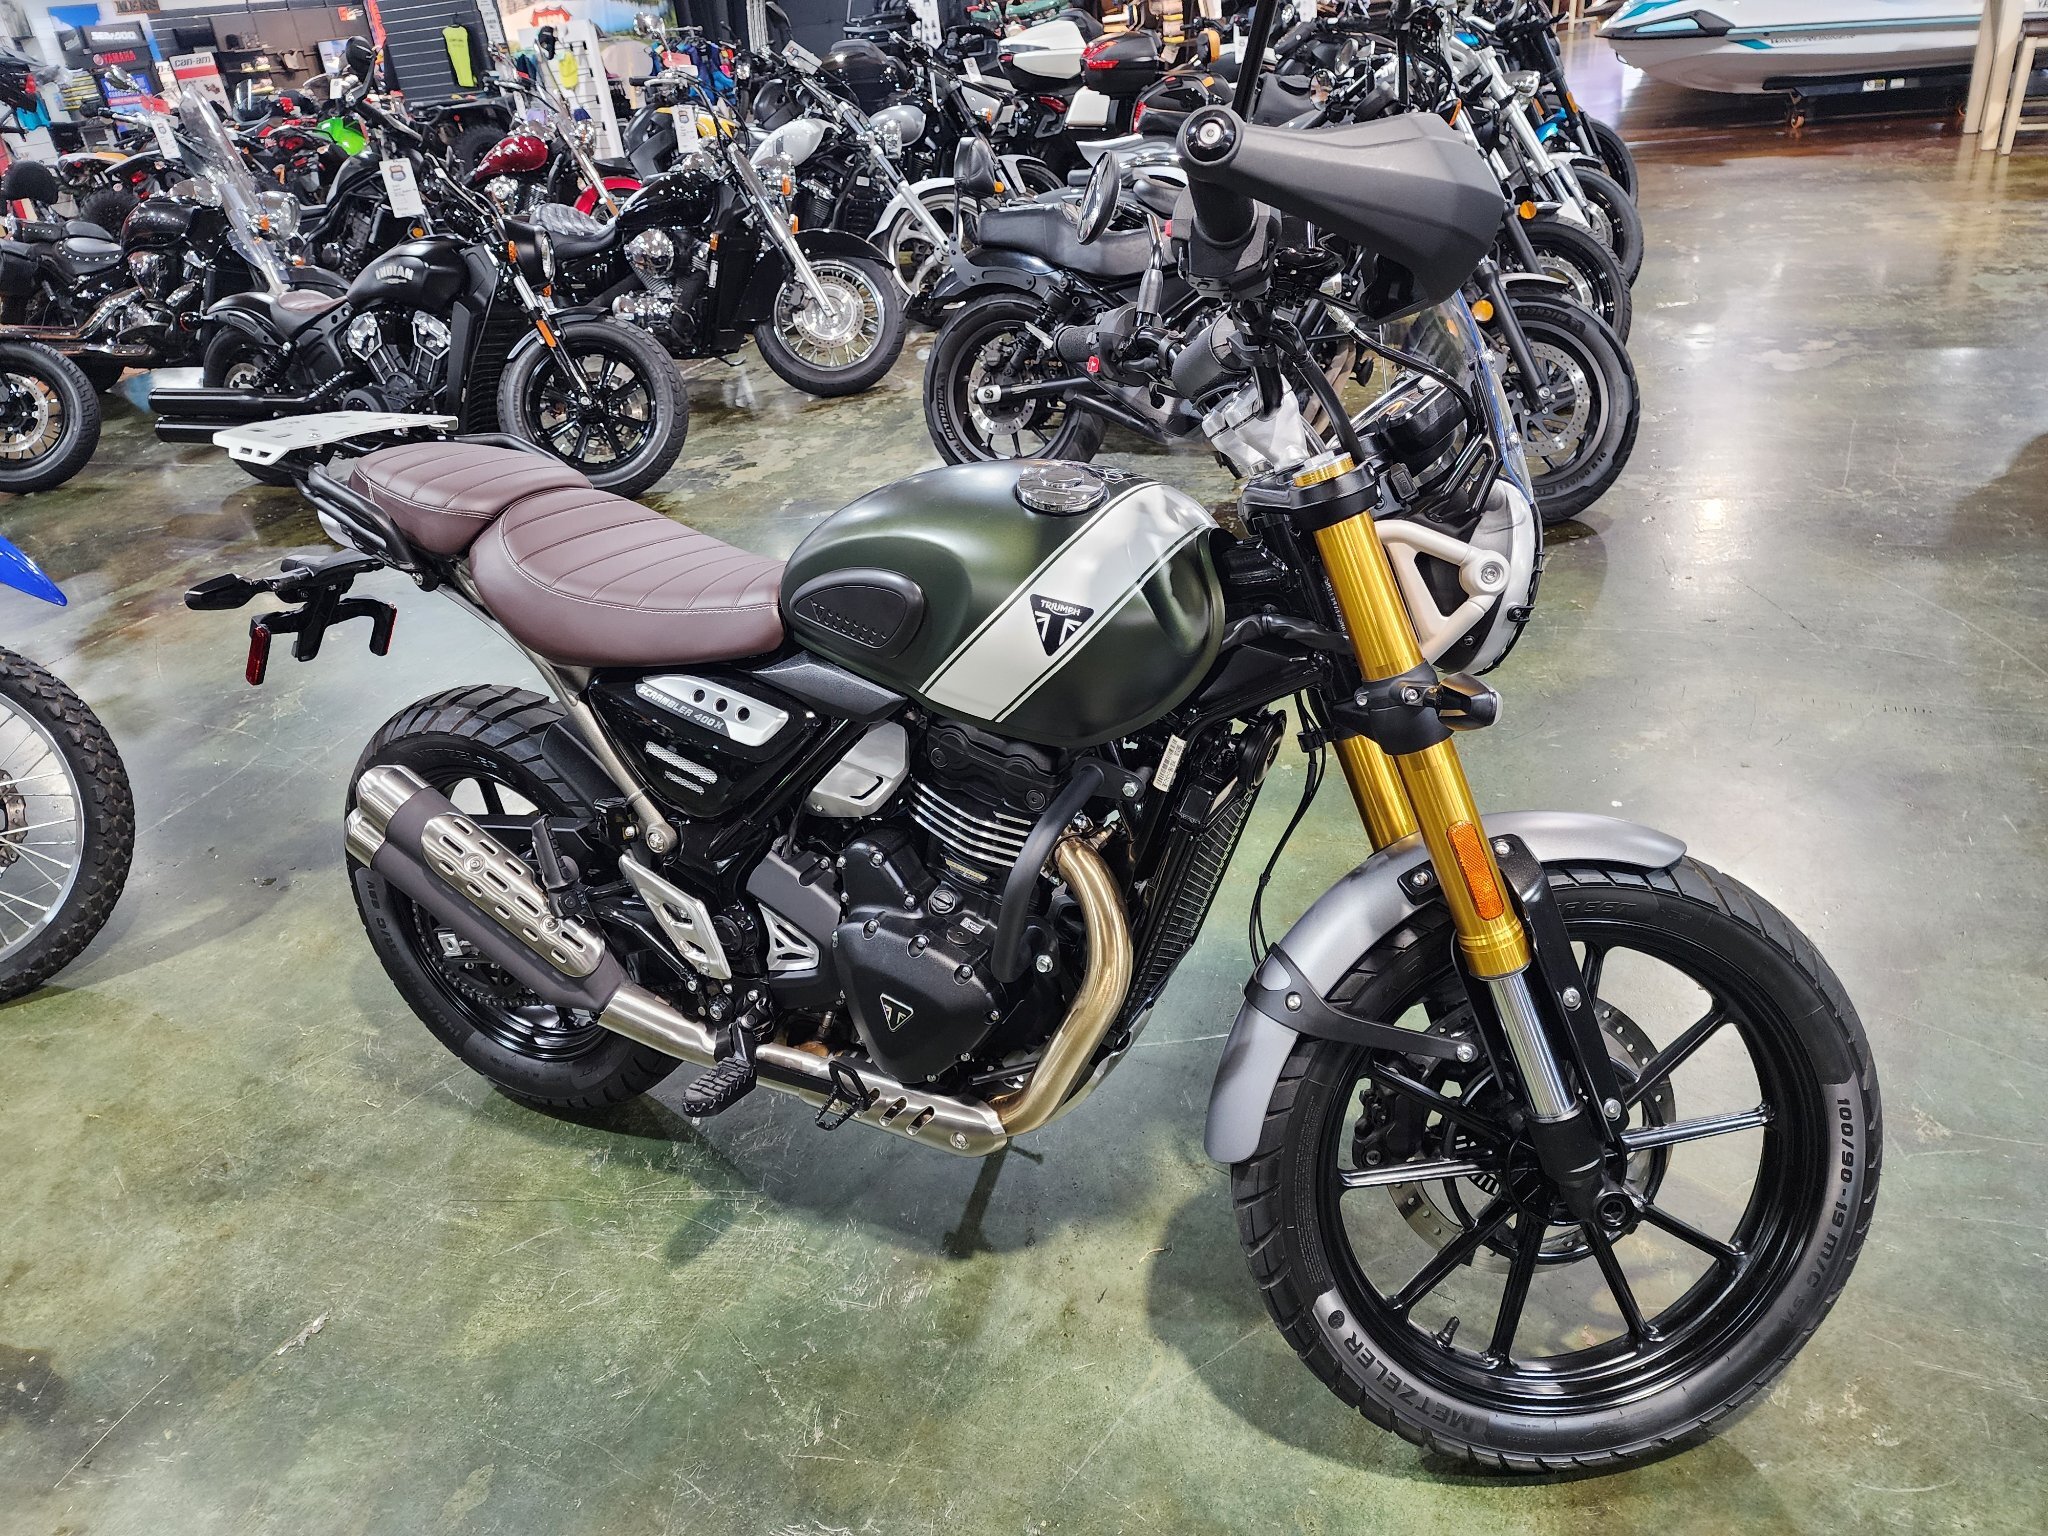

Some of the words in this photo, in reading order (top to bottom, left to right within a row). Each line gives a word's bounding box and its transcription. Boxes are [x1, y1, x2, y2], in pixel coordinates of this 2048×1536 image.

[375, 265, 414, 281] INDIAN
[937, 388, 955, 440] MICHELIN
[1040, 599, 1081, 617] TRIUMPH
[638, 685, 693, 716] SCRAMBLER
[1343, 1330, 1475, 1433] METZELER
